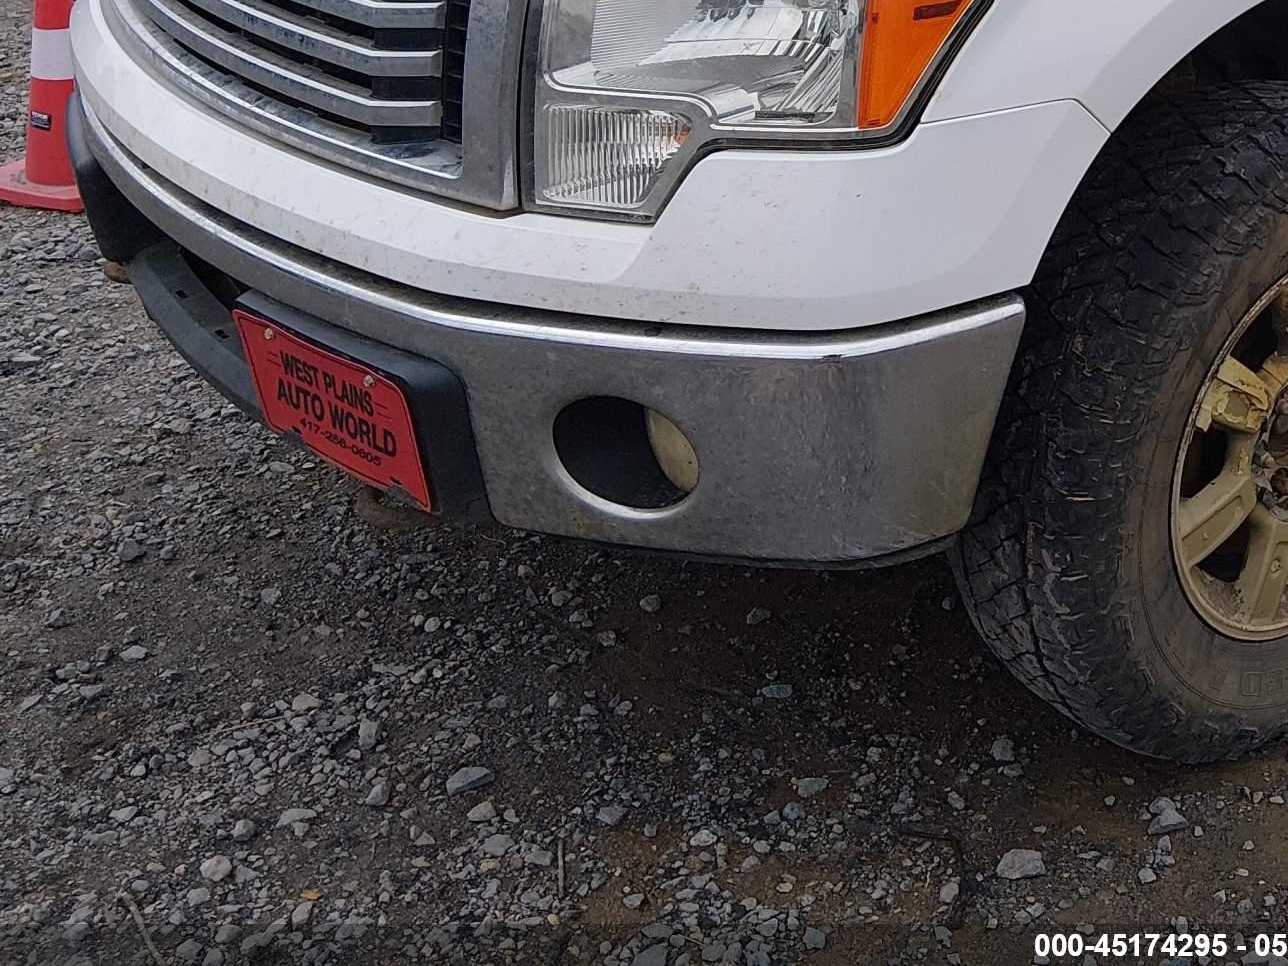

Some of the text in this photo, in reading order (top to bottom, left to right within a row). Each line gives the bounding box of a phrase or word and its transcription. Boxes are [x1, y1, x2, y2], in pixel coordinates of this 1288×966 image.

[278, 380, 397, 458] AUTO WORLD
[282, 352, 374, 416] WEST PLAINS
